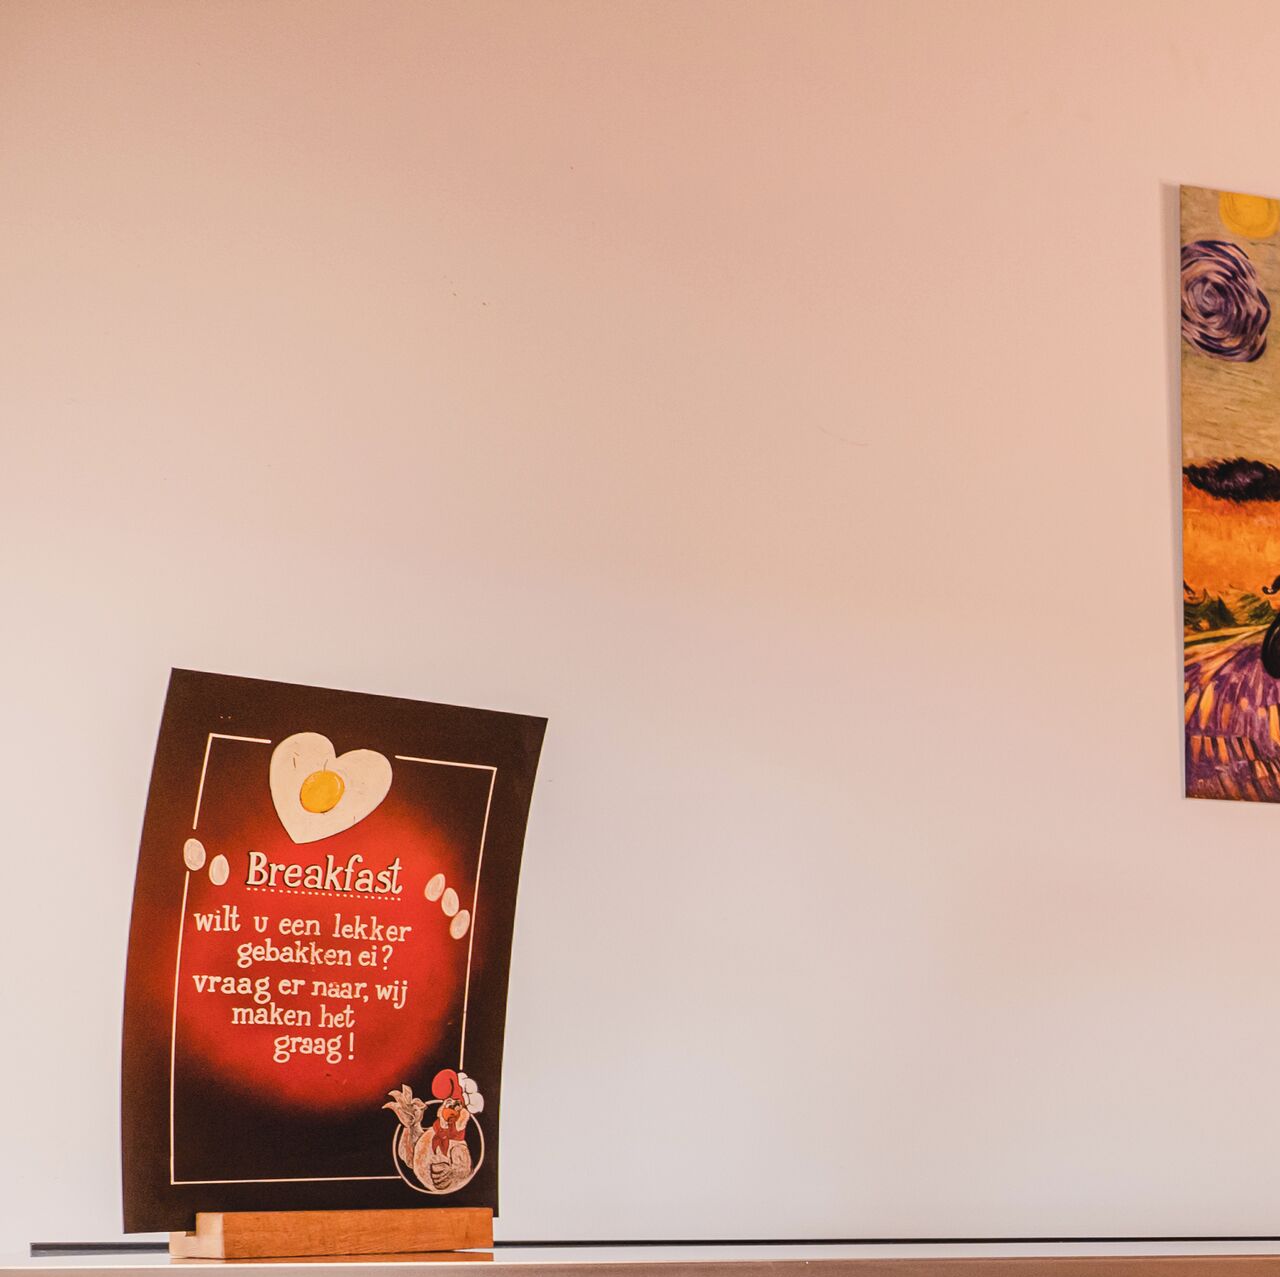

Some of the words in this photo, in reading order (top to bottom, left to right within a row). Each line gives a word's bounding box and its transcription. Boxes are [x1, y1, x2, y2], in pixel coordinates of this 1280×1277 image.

[246, 851, 403, 894] Breakfast
[193, 905, 241, 932] wilt
[253, 916, 269, 933] u
[279, 917, 321, 936] een
[332, 913, 412, 942] lekker
[237, 938, 351, 968] gebakken
[192, 975, 271, 1004] vraag
[278, 979, 305, 995] er
[311, 980, 369, 1003] naar,
[376, 980, 408, 1009] wij
[231, 1002, 311, 1026] maken
[318, 1004, 355, 1028] het
